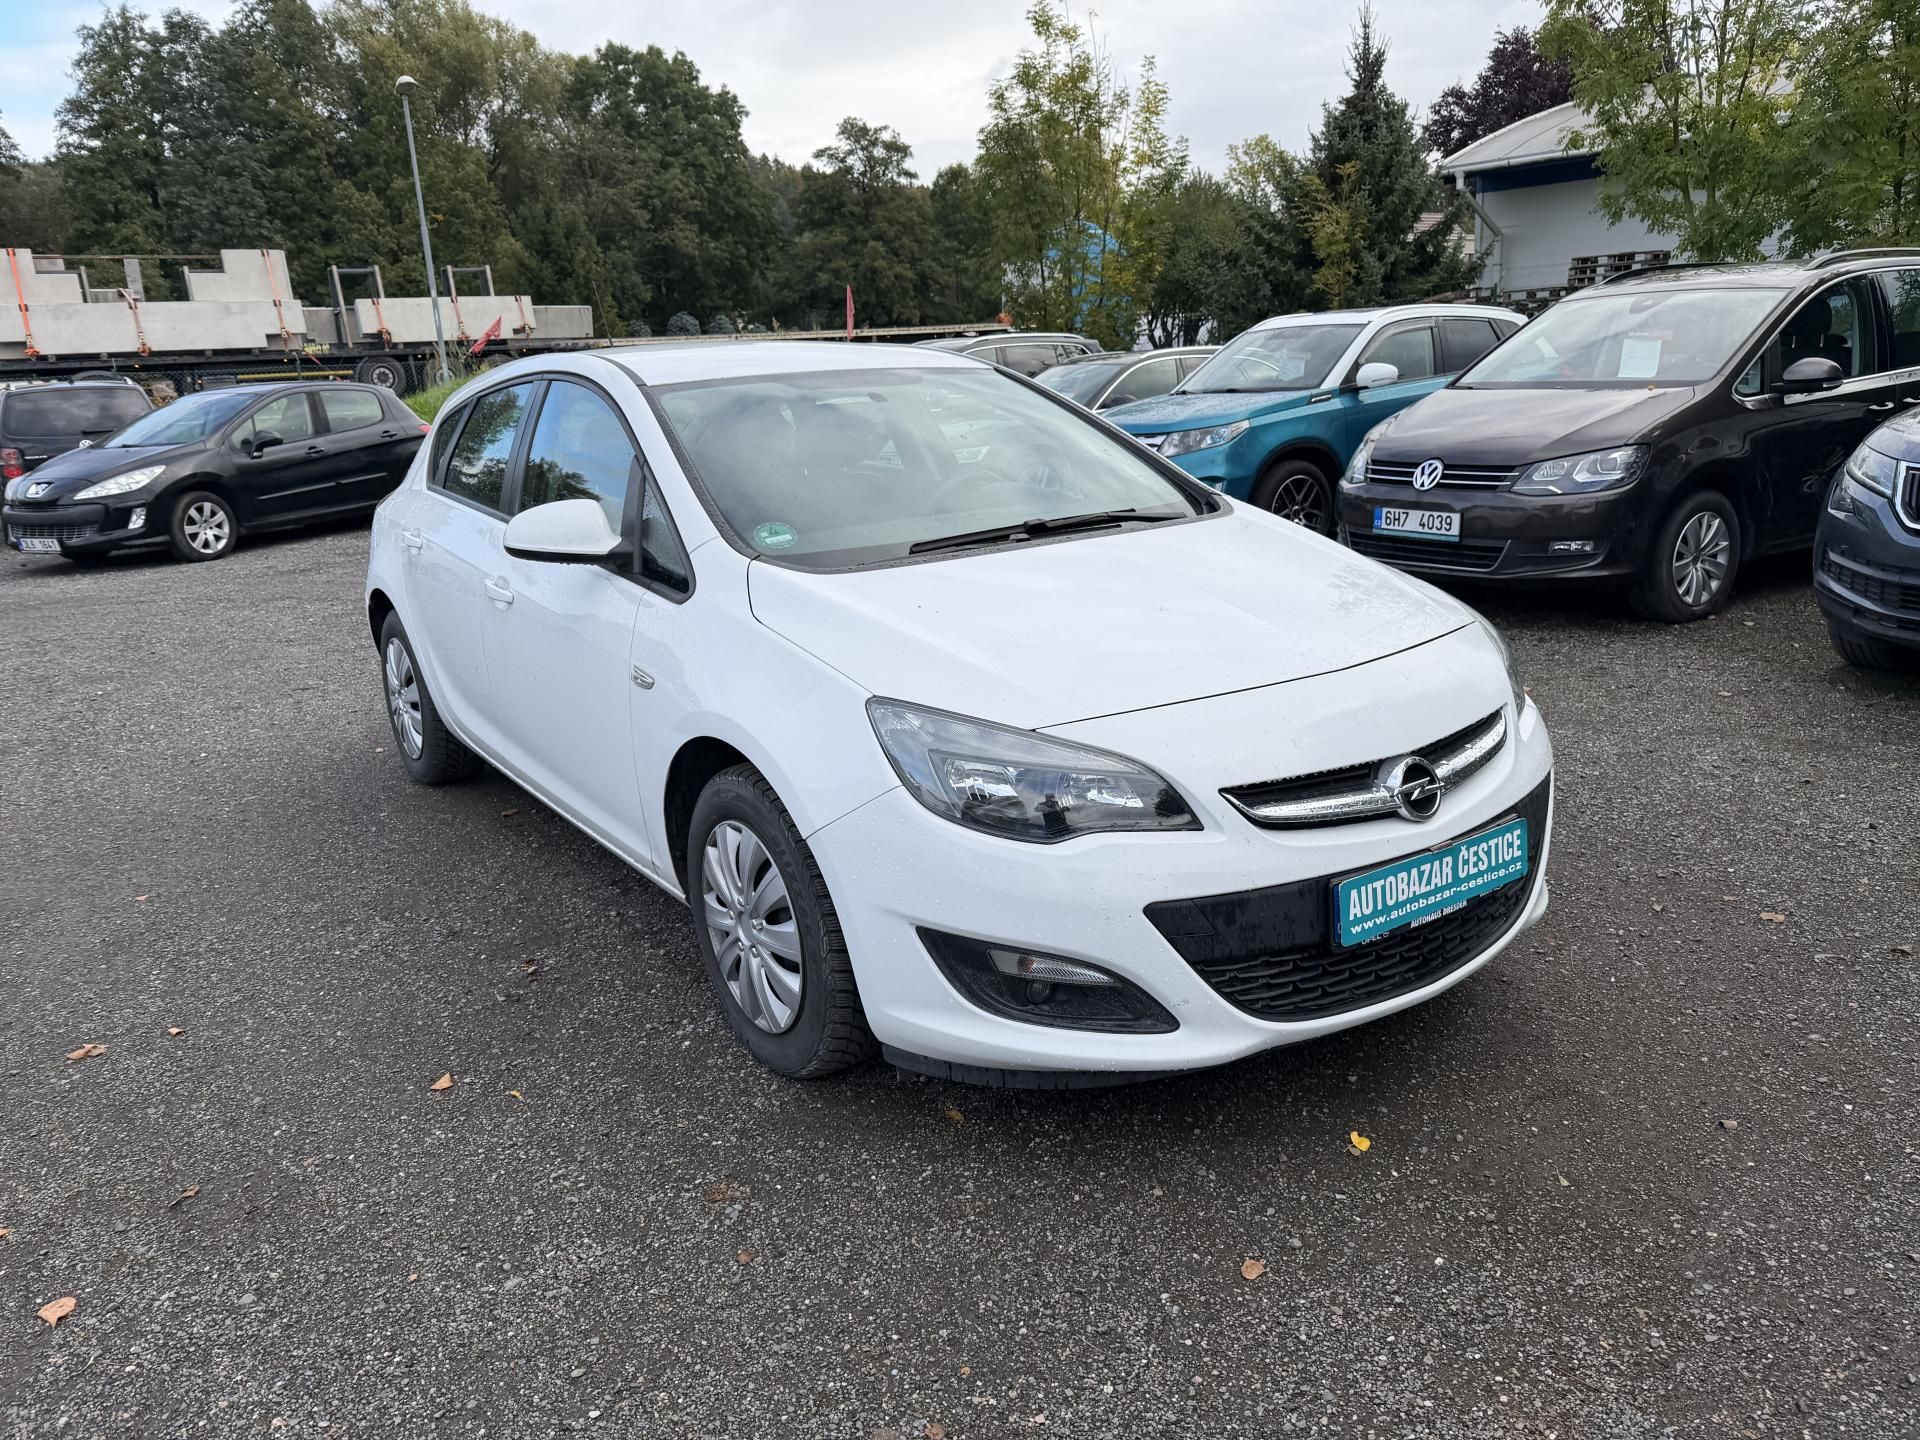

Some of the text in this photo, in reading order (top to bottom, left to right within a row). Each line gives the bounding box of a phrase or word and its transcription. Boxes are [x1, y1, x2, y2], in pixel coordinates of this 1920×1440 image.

[1385, 511, 1409, 528] 6H7
[1419, 513, 1452, 532] 4039
[1349, 829, 1522, 920] AUTOBAZAR ČESTICE
[1350, 861, 1522, 935] www.autobazar-cestice.cz
[1410, 909, 1442, 928] AUTOHAUS
